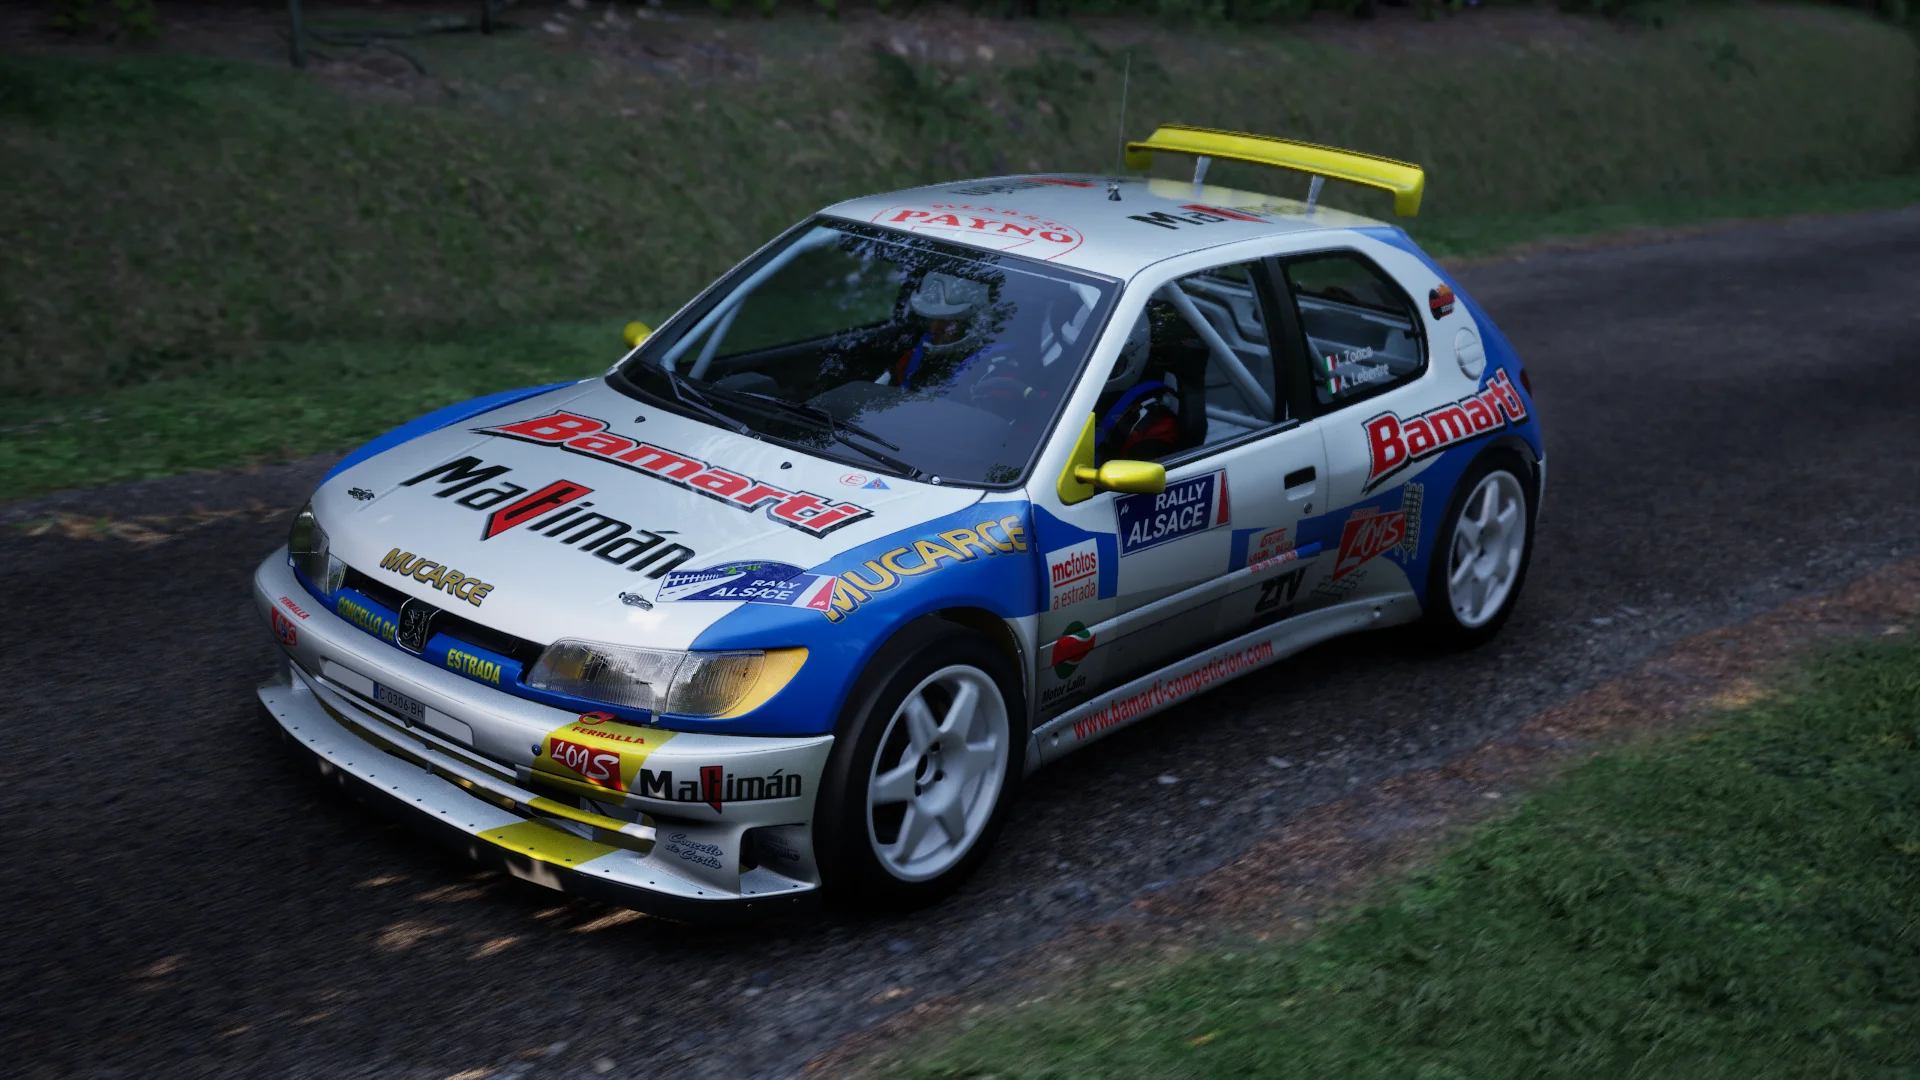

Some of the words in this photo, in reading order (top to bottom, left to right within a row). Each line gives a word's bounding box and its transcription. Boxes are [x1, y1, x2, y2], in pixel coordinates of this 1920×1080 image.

[889, 210, 1074, 243] PAYNO
[1361, 367, 1530, 495] Bamarti
[468, 409, 876, 539] Bamarti
[1155, 481, 1206, 512] RALLY
[1126, 502, 1206, 548] ALSACE
[379, 547, 495, 608] MUCARCE
[818, 514, 1031, 624] MUCARCE
[1051, 550, 1097, 582] mcfotos
[709, 587, 795, 601] ALSACE
[751, 579, 801, 591] RALLY
[1053, 595, 1060, 611] a
[1061, 577, 1097, 608] estrada
[337, 596, 382, 635] CONCELLO
[382, 620, 396, 642] DA
[446, 648, 502, 685] ESTRADA
[1041, 685, 1065, 705] Motor
[1073, 639, 1275, 741] www.bamarti-competicion.com
[572, 726, 645, 745] FERRALLA
[664, 844, 680, 853] de
[668, 832, 723, 857] Concello
